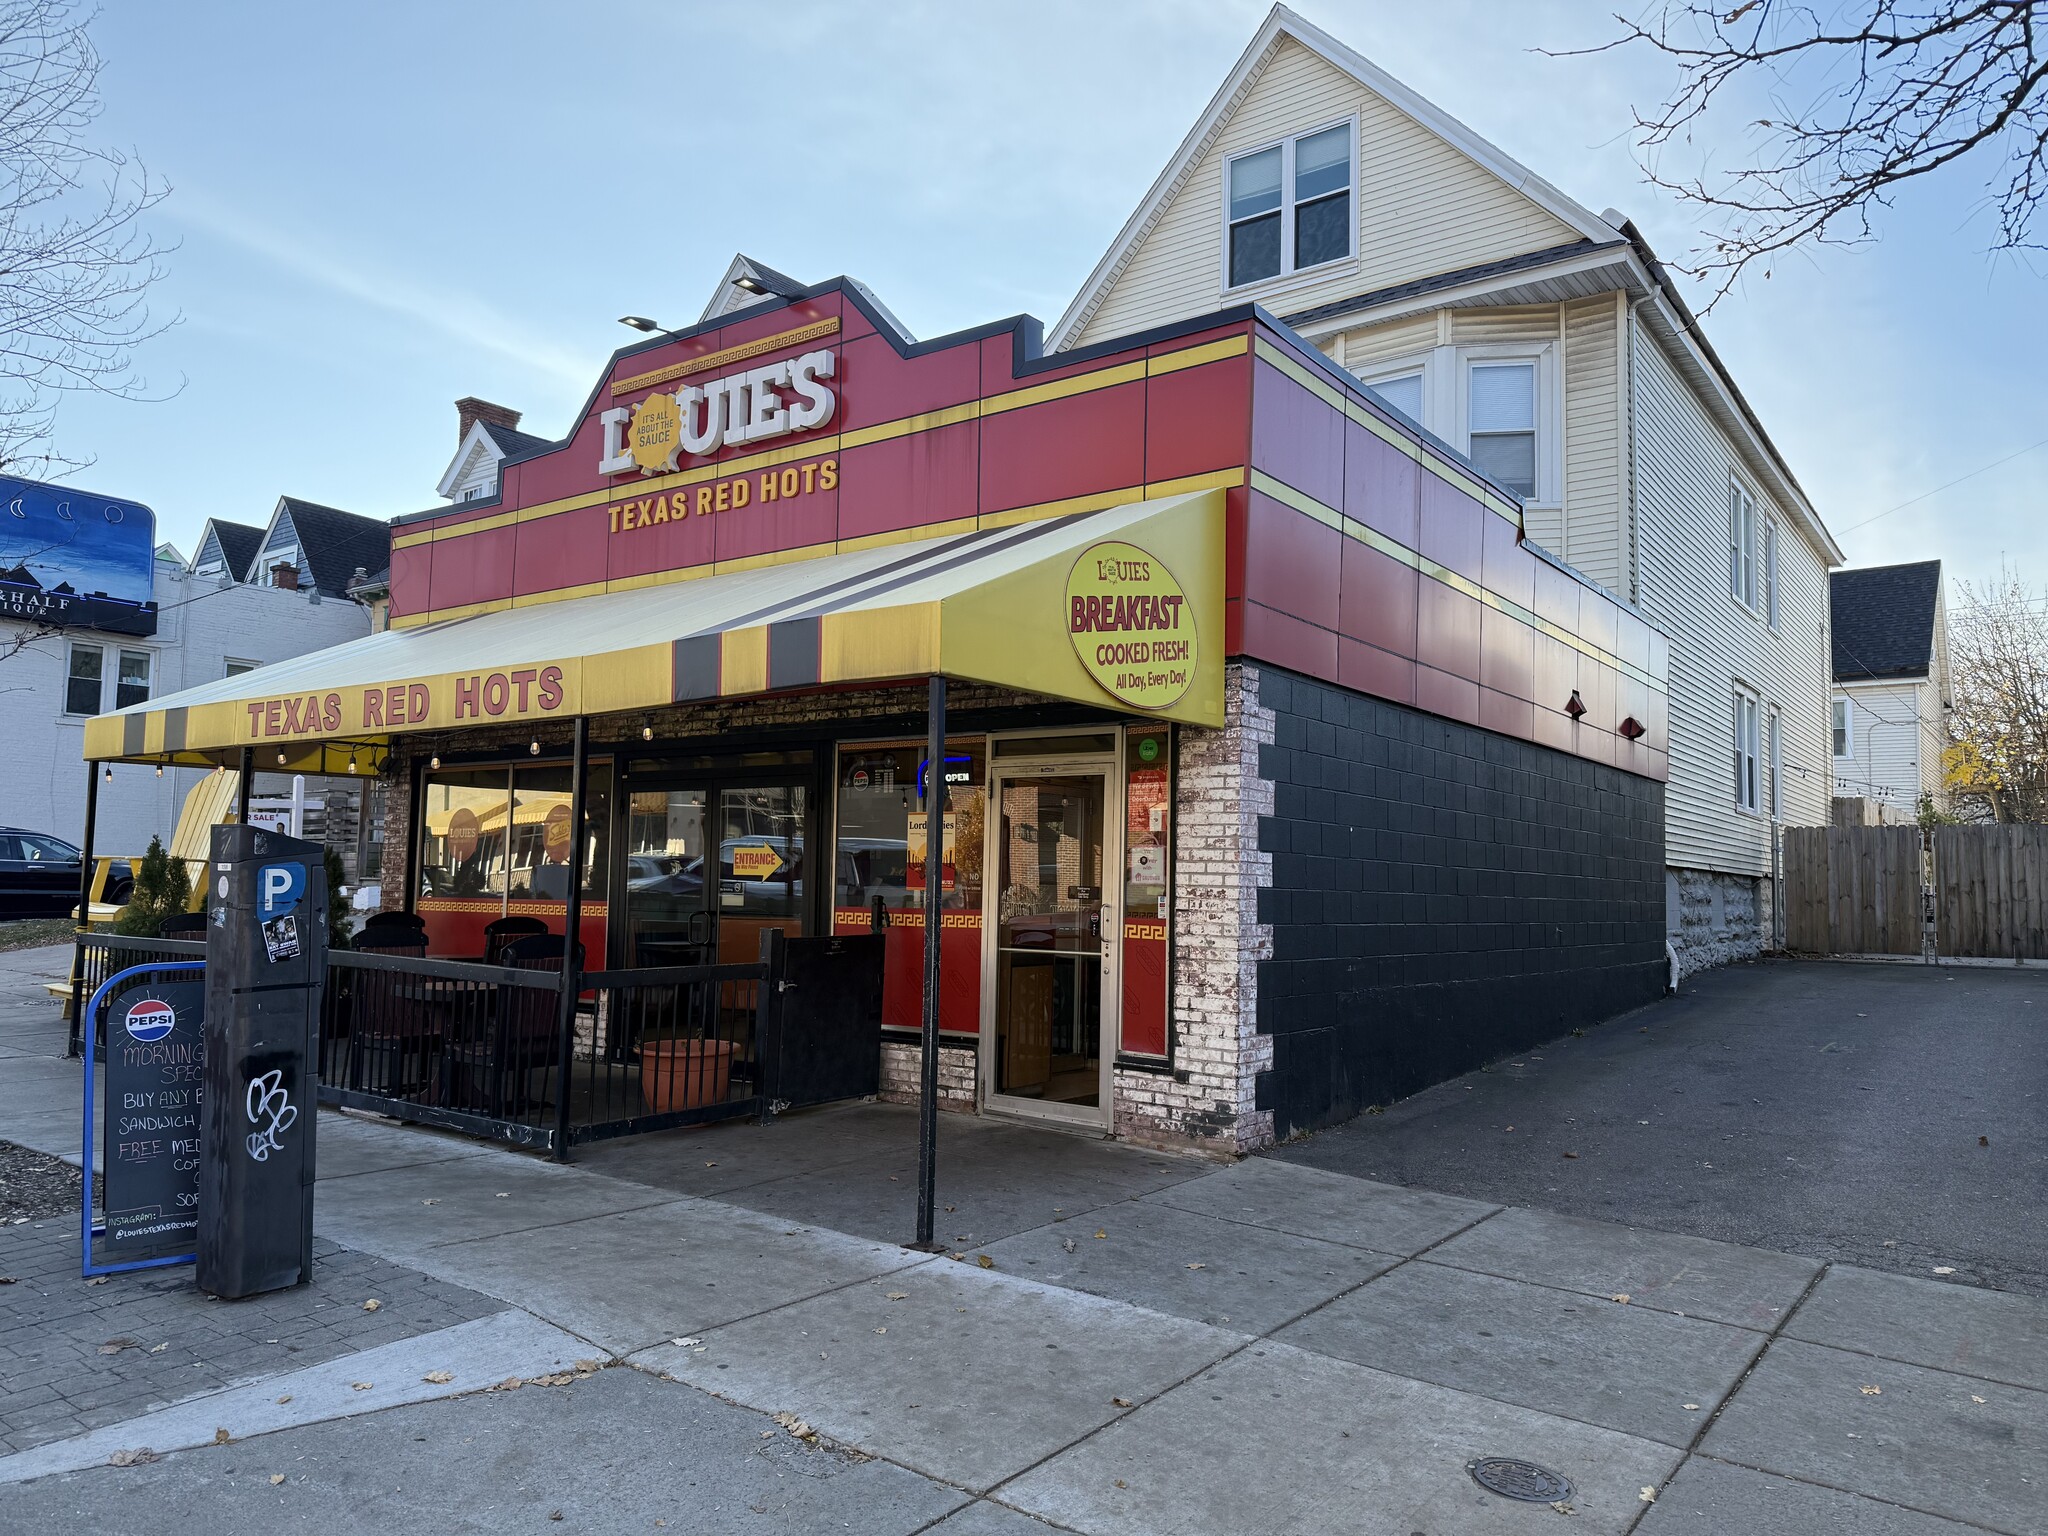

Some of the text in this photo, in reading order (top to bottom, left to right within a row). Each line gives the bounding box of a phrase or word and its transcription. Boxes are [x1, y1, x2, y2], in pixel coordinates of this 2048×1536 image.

[642, 410, 669, 424] IT'S ALL
[636, 418, 674, 436] ABOUT THE
[639, 429, 671, 448] SAUCE
[608, 459, 839, 533] TEXAS RED HOTS
[3, 601, 48, 616] IQUE
[1071, 595, 1183, 633] BREAKFAST
[1096, 640, 1189, 666] COOKED FRESH!
[1115, 668, 1187, 691] All Day, Every Day!
[247, 665, 564, 738] TEXAS RED HOTS
[945, 772, 970, 782] OPEN
[909, 820, 955, 830] Lord ies
[735, 853, 775, 865] ENTRANCE
[969, 872, 980, 881] NO
[264, 868, 293, 911] P
[128, 1015, 172, 1027] PEPSI
[123, 1042, 204, 1068] MORNING
[160, 1064, 203, 1085] SPEC
[123, 1091, 155, 1109] BUY
[159, 1089, 190, 1106] ANY
[118, 1139, 165, 1160] FREE
[173, 1158, 200, 1171] COF
[175, 1192, 200, 1207] SOF
[108, 1212, 157, 1227] INSTAGRAM:
